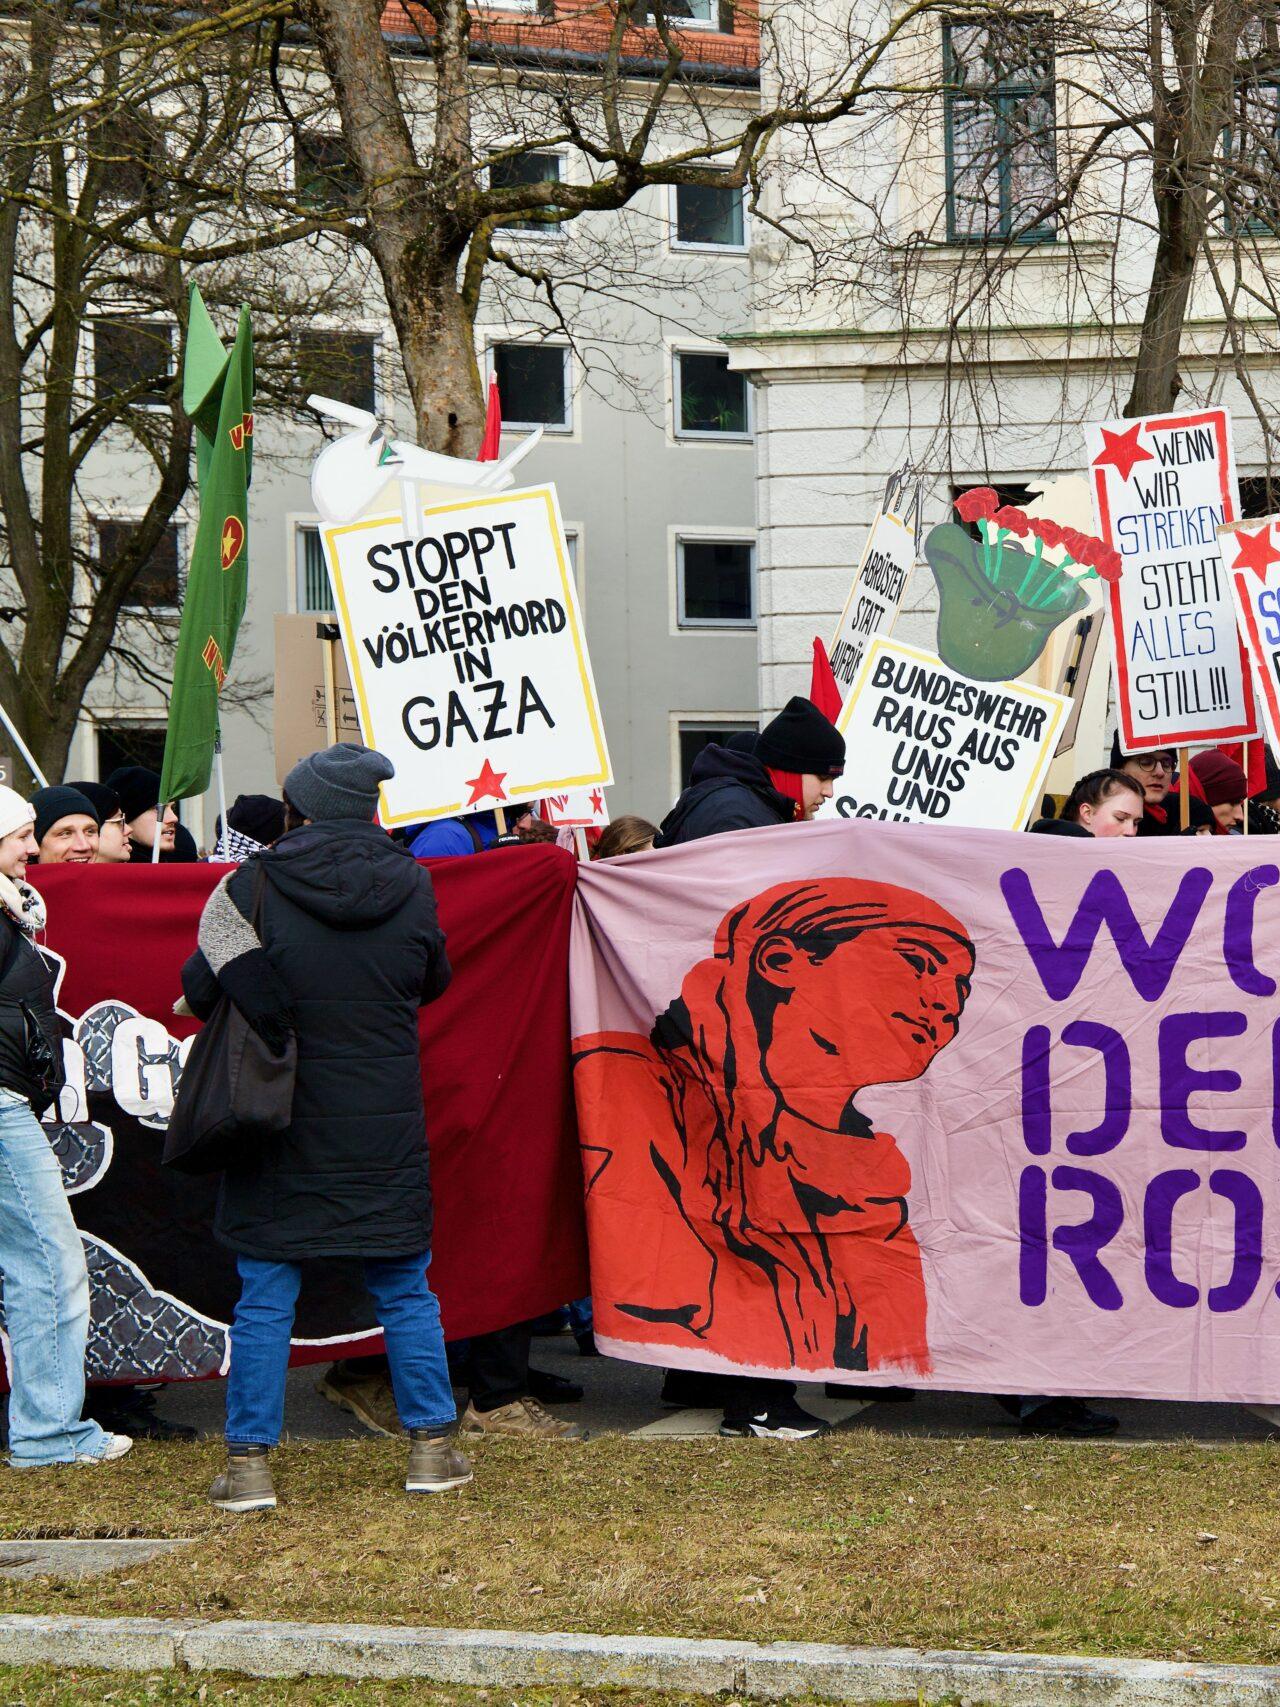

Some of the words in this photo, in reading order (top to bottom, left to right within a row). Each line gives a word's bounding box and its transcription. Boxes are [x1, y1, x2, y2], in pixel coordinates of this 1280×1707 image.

[1152, 427, 1215, 467] WENN
[1133, 470, 1181, 509] WIR
[1117, 504, 1226, 556] STREIKEN
[367, 522, 516, 593] STOPPT
[859, 548, 908, 606] ABRÜSTEN
[1141, 556, 1223, 611] STEHT
[413, 576, 492, 621] DEN
[851, 595, 886, 636] STATT
[362, 597, 567, 669] VÖLKERMORD
[1131, 610, 1216, 662] ALLES
[453, 646, 492, 684] IN
[402, 675, 556, 751] GAZA
[871, 655, 1047, 743] BUNDESWEHR
[1135, 666, 1231, 720] STILL!!!
[872, 695, 956, 749] RAUS
[957, 728, 1020, 772] AUS
[891, 741, 970, 793] UNIS
[886, 776, 951, 819] UND
